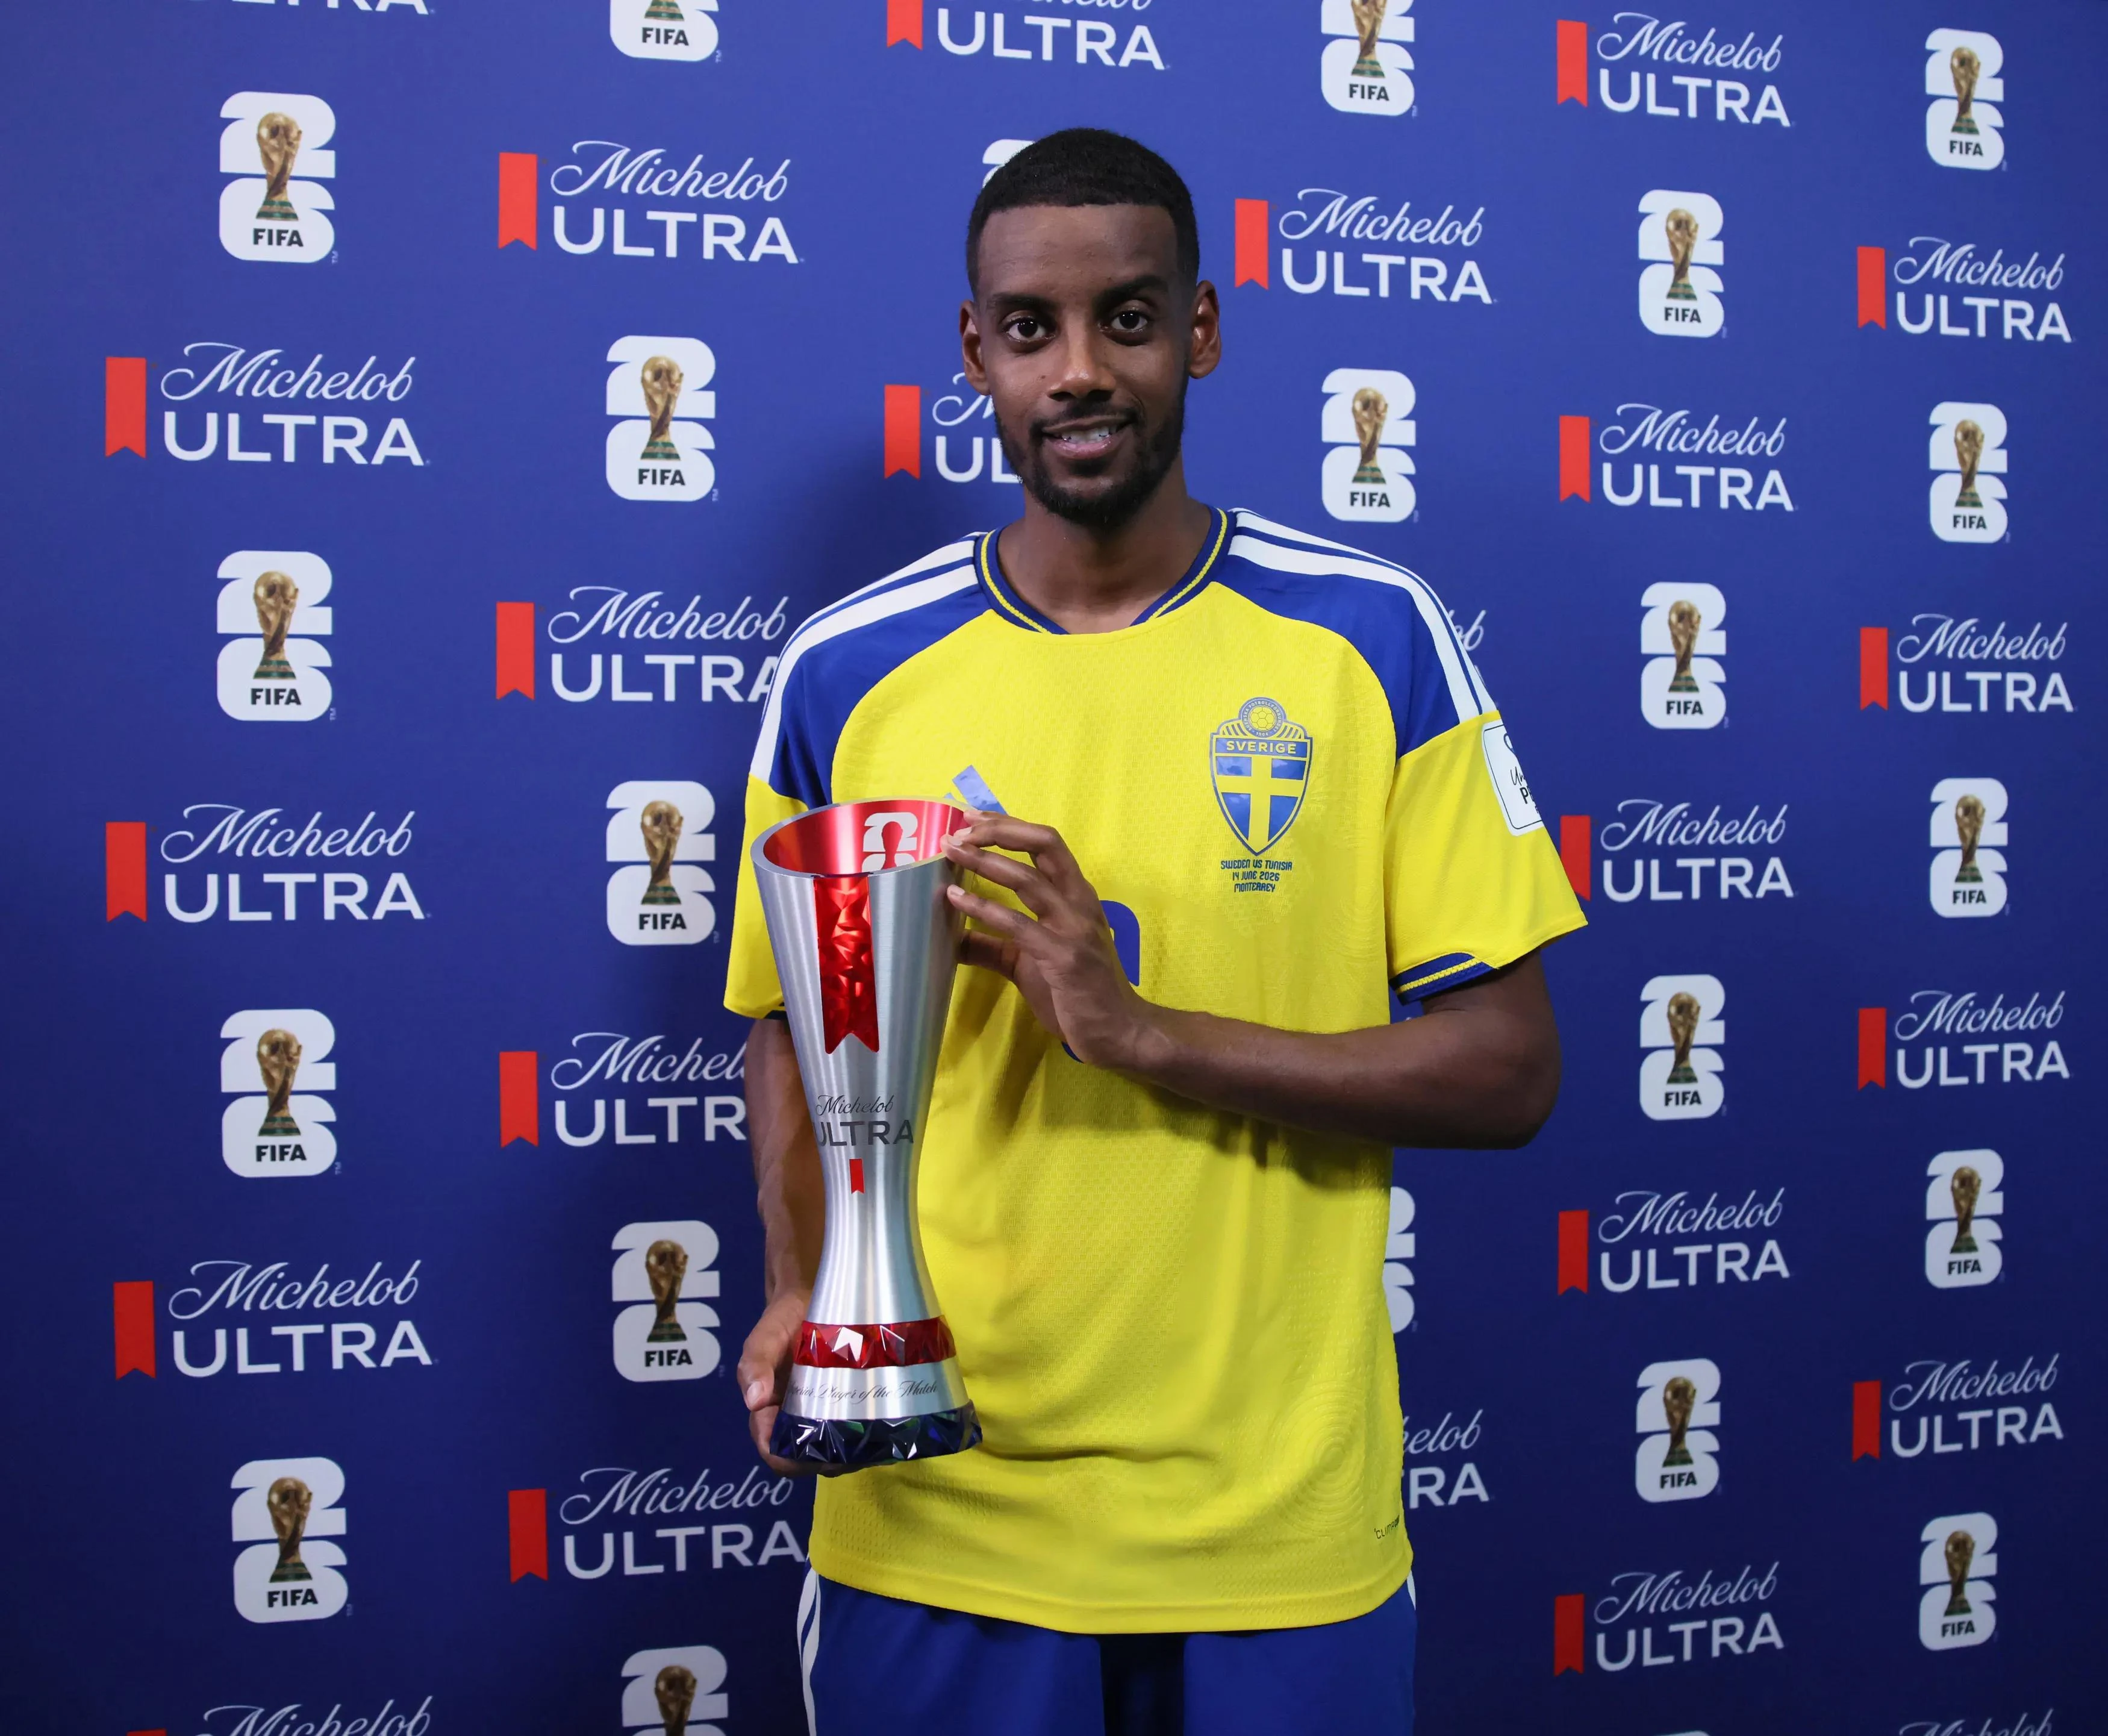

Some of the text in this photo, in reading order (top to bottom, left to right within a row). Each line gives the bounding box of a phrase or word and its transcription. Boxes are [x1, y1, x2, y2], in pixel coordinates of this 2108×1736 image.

[642, 27, 689, 46] FIFA
[938, 8, 1165, 70] ULTRA
[1597, 13, 1783, 72] Michelob
[1349, 84, 1389, 101] FIFA
[1600, 69, 1791, 126] ULTRA
[550, 141, 790, 201] Michelob
[1950, 140, 1983, 156] FIFA
[254, 228, 304, 247] FIFA
[554, 206, 798, 263] ULTRA
[1279, 189, 1484, 246] Michelob
[1282, 248, 1492, 304] ULTRA
[1894, 237, 2065, 290] Michelob
[1665, 307, 1701, 323] FIFA
[1897, 292, 2071, 343] ULTRA
[161, 342, 416, 401] Michelob
[164, 411, 425, 466] ULTRA
[1600, 404, 1786, 456] Michelob
[638, 469, 685, 486] FIFA
[1350, 492, 1390, 507] FIFA
[1603, 463, 1794, 511] ULTRA
[1953, 515, 1986, 529] FIFA
[548, 586, 788, 643] Michelob
[1897, 614, 2067, 663] Michelob
[251, 688, 301, 705] FIFA
[1667, 701, 1703, 714] FIFA
[1899, 671, 2073, 712] ULTRA
[1226, 740, 1297, 754] SVERIGE
[161, 804, 414, 863] Michelob
[1601, 799, 1788, 851] Michelob
[1220, 859, 1250, 869] SWEDEN
[1265, 860, 1293, 871] TUNISIA
[1232, 871, 1280, 881] 14 JUNE 2026
[1233, 882, 1275, 892] MONTERREY
[1603, 857, 1794, 902] ULTRA
[165, 873, 425, 922] ULTRA
[1953, 890, 1986, 904] FIFA
[639, 913, 687, 930] FIFA
[1895, 991, 2065, 1040] Michelob
[551, 1032, 746, 1090] Michel
[1897, 1041, 2069, 1088] ULTRA
[555, 1096, 746, 1146] ULTR
[815, 1094, 895, 1116] Michelob
[1665, 1090, 1701, 1106] FIFA
[256, 1144, 307, 1162] FIFA
[1599, 1188, 1784, 1243] Michelob
[169, 1260, 421, 1319] Michelob
[1601, 1240, 1789, 1292] ULTRA
[1948, 1260, 1982, 1275] FIFA
[173, 1320, 432, 1377] ULTRA
[645, 1349, 693, 1367] FIFA
[897, 1378, 938, 1398] Match
[1890, 1354, 2059, 1411] Michelob
[1891, 1403, 2063, 1457] ULTRA
[1660, 1472, 1697, 1489] FIFA
[564, 1521, 805, 1579] ULTRA
[267, 1588, 318, 1608] FIFA
[1595, 1562, 1779, 1623] Michelob
[1597, 1613, 1784, 1671] ULTRA
[1942, 1620, 1975, 1637] FIFA
